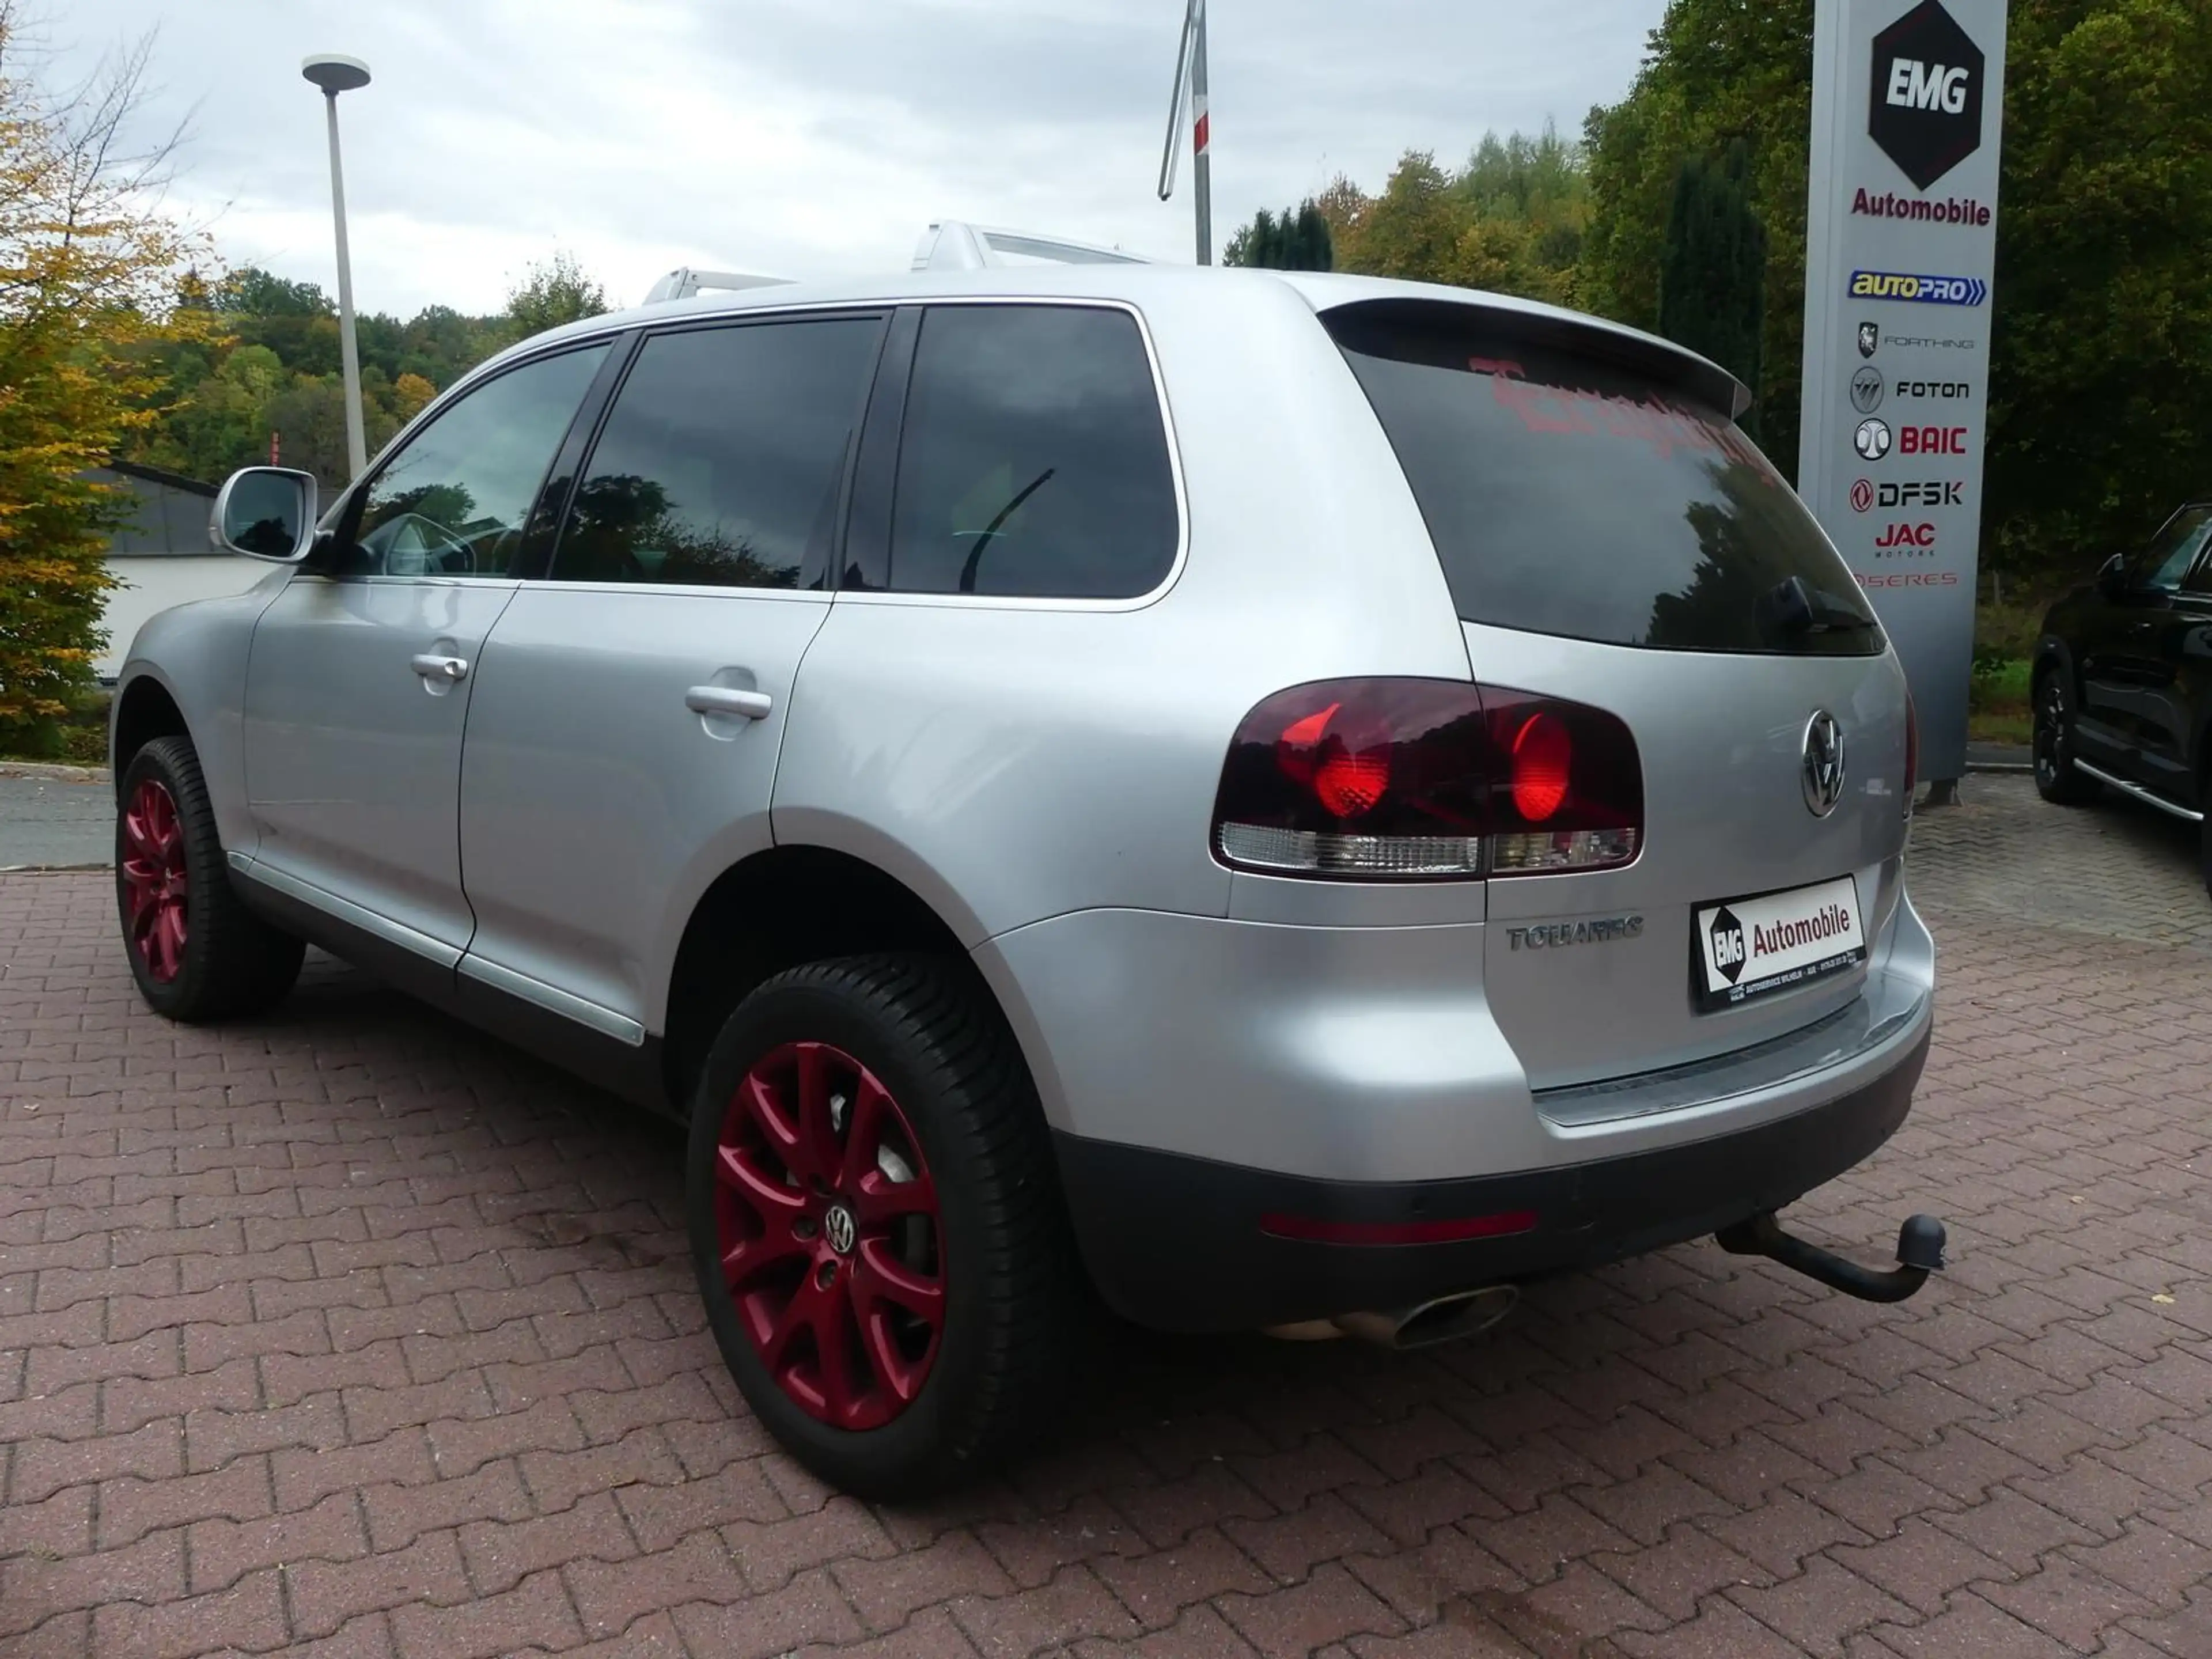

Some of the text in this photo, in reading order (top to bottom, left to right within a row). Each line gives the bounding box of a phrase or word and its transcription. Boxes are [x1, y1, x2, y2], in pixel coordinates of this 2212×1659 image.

[1886, 57, 1969, 114] EMG
[1851, 187, 1991, 226] Automobile
[1884, 335, 1975, 349] FORTHING
[1896, 381, 1969, 399] FOTON
[1900, 427, 1967, 454] BAIC
[1878, 482, 1963, 507] DFSK
[1876, 523, 1936, 547] JAC
[1868, 573, 1958, 588] SERES
[1753, 904, 1850, 958] Automobile
[1714, 929, 1743, 967] EMG
